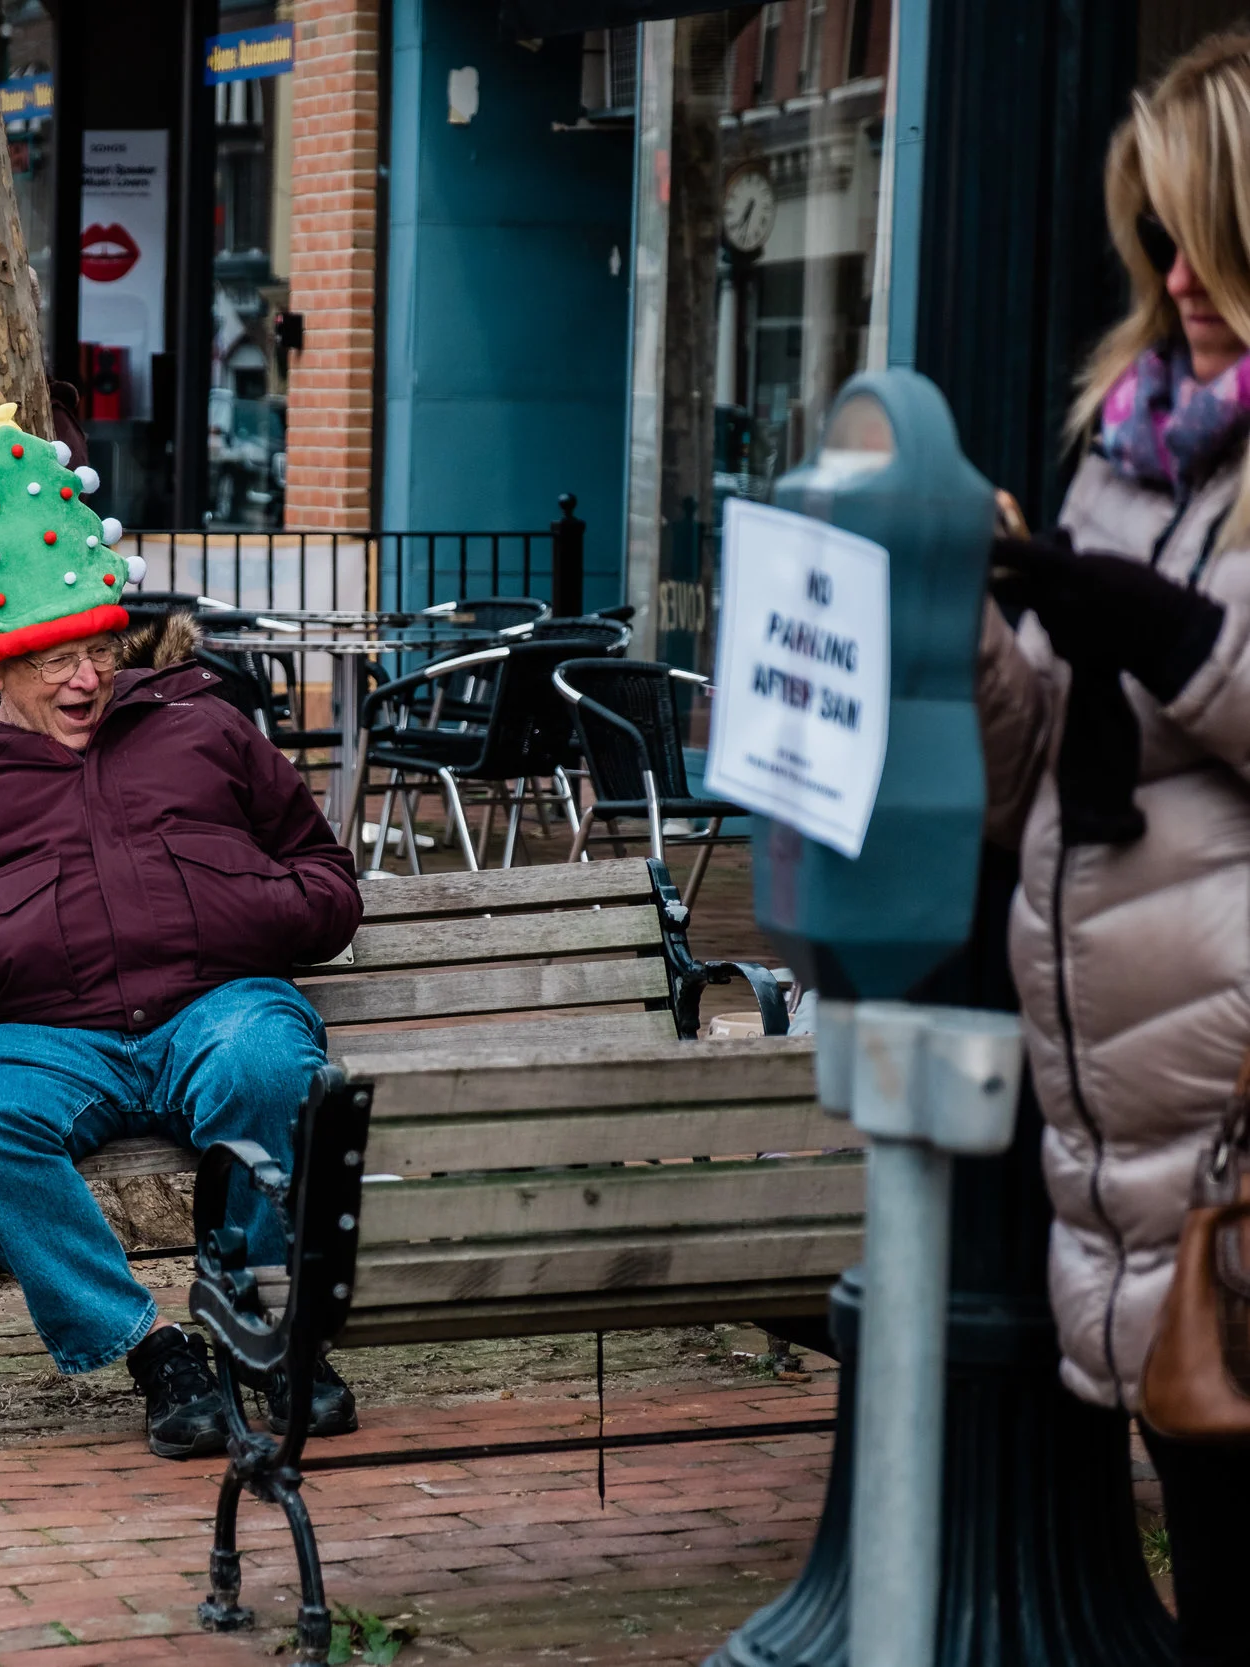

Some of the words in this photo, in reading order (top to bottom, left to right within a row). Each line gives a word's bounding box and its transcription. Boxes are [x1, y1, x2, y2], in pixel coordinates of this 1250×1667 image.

[806, 568, 833, 608] NO
[767, 610, 859, 673] PARKING
[752, 662, 813, 712] AFTER
